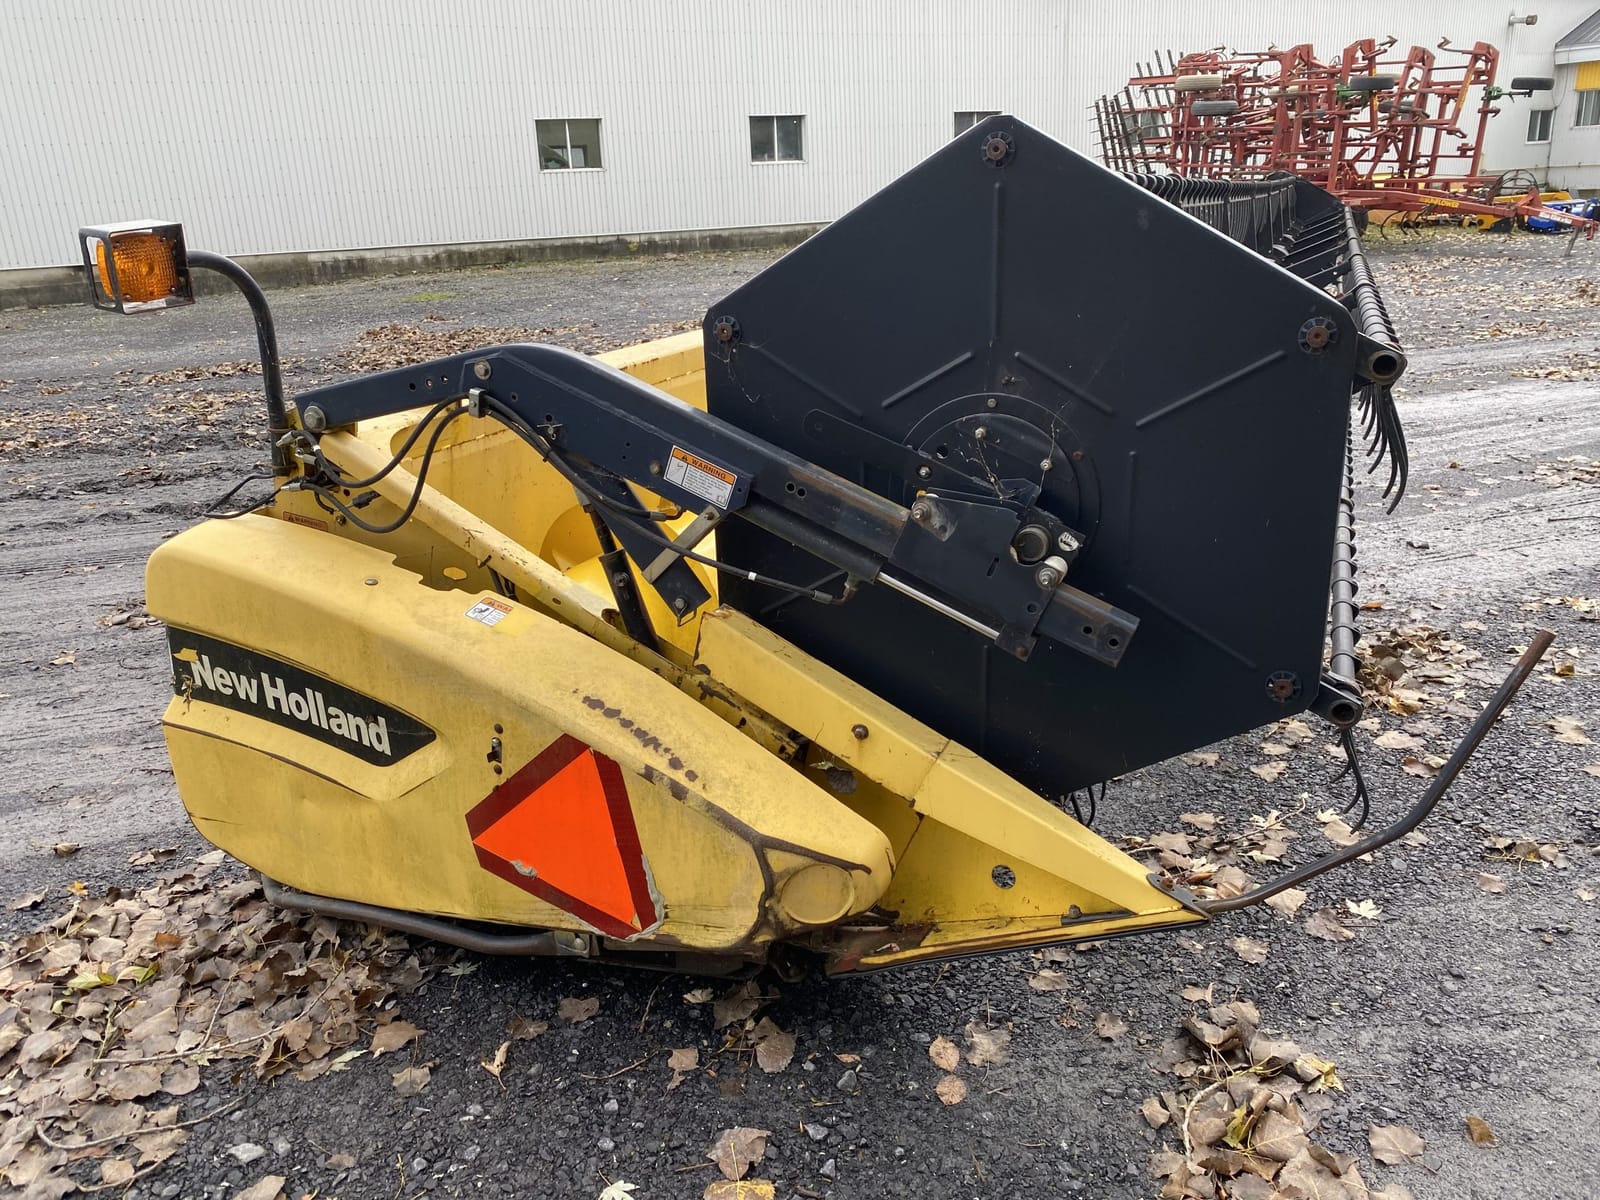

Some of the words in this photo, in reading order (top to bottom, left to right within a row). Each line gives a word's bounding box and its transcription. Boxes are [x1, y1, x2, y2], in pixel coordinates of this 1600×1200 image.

[692, 459, 726, 479] WARNING
[192, 656, 258, 704] New
[260, 672, 392, 756] Holland
